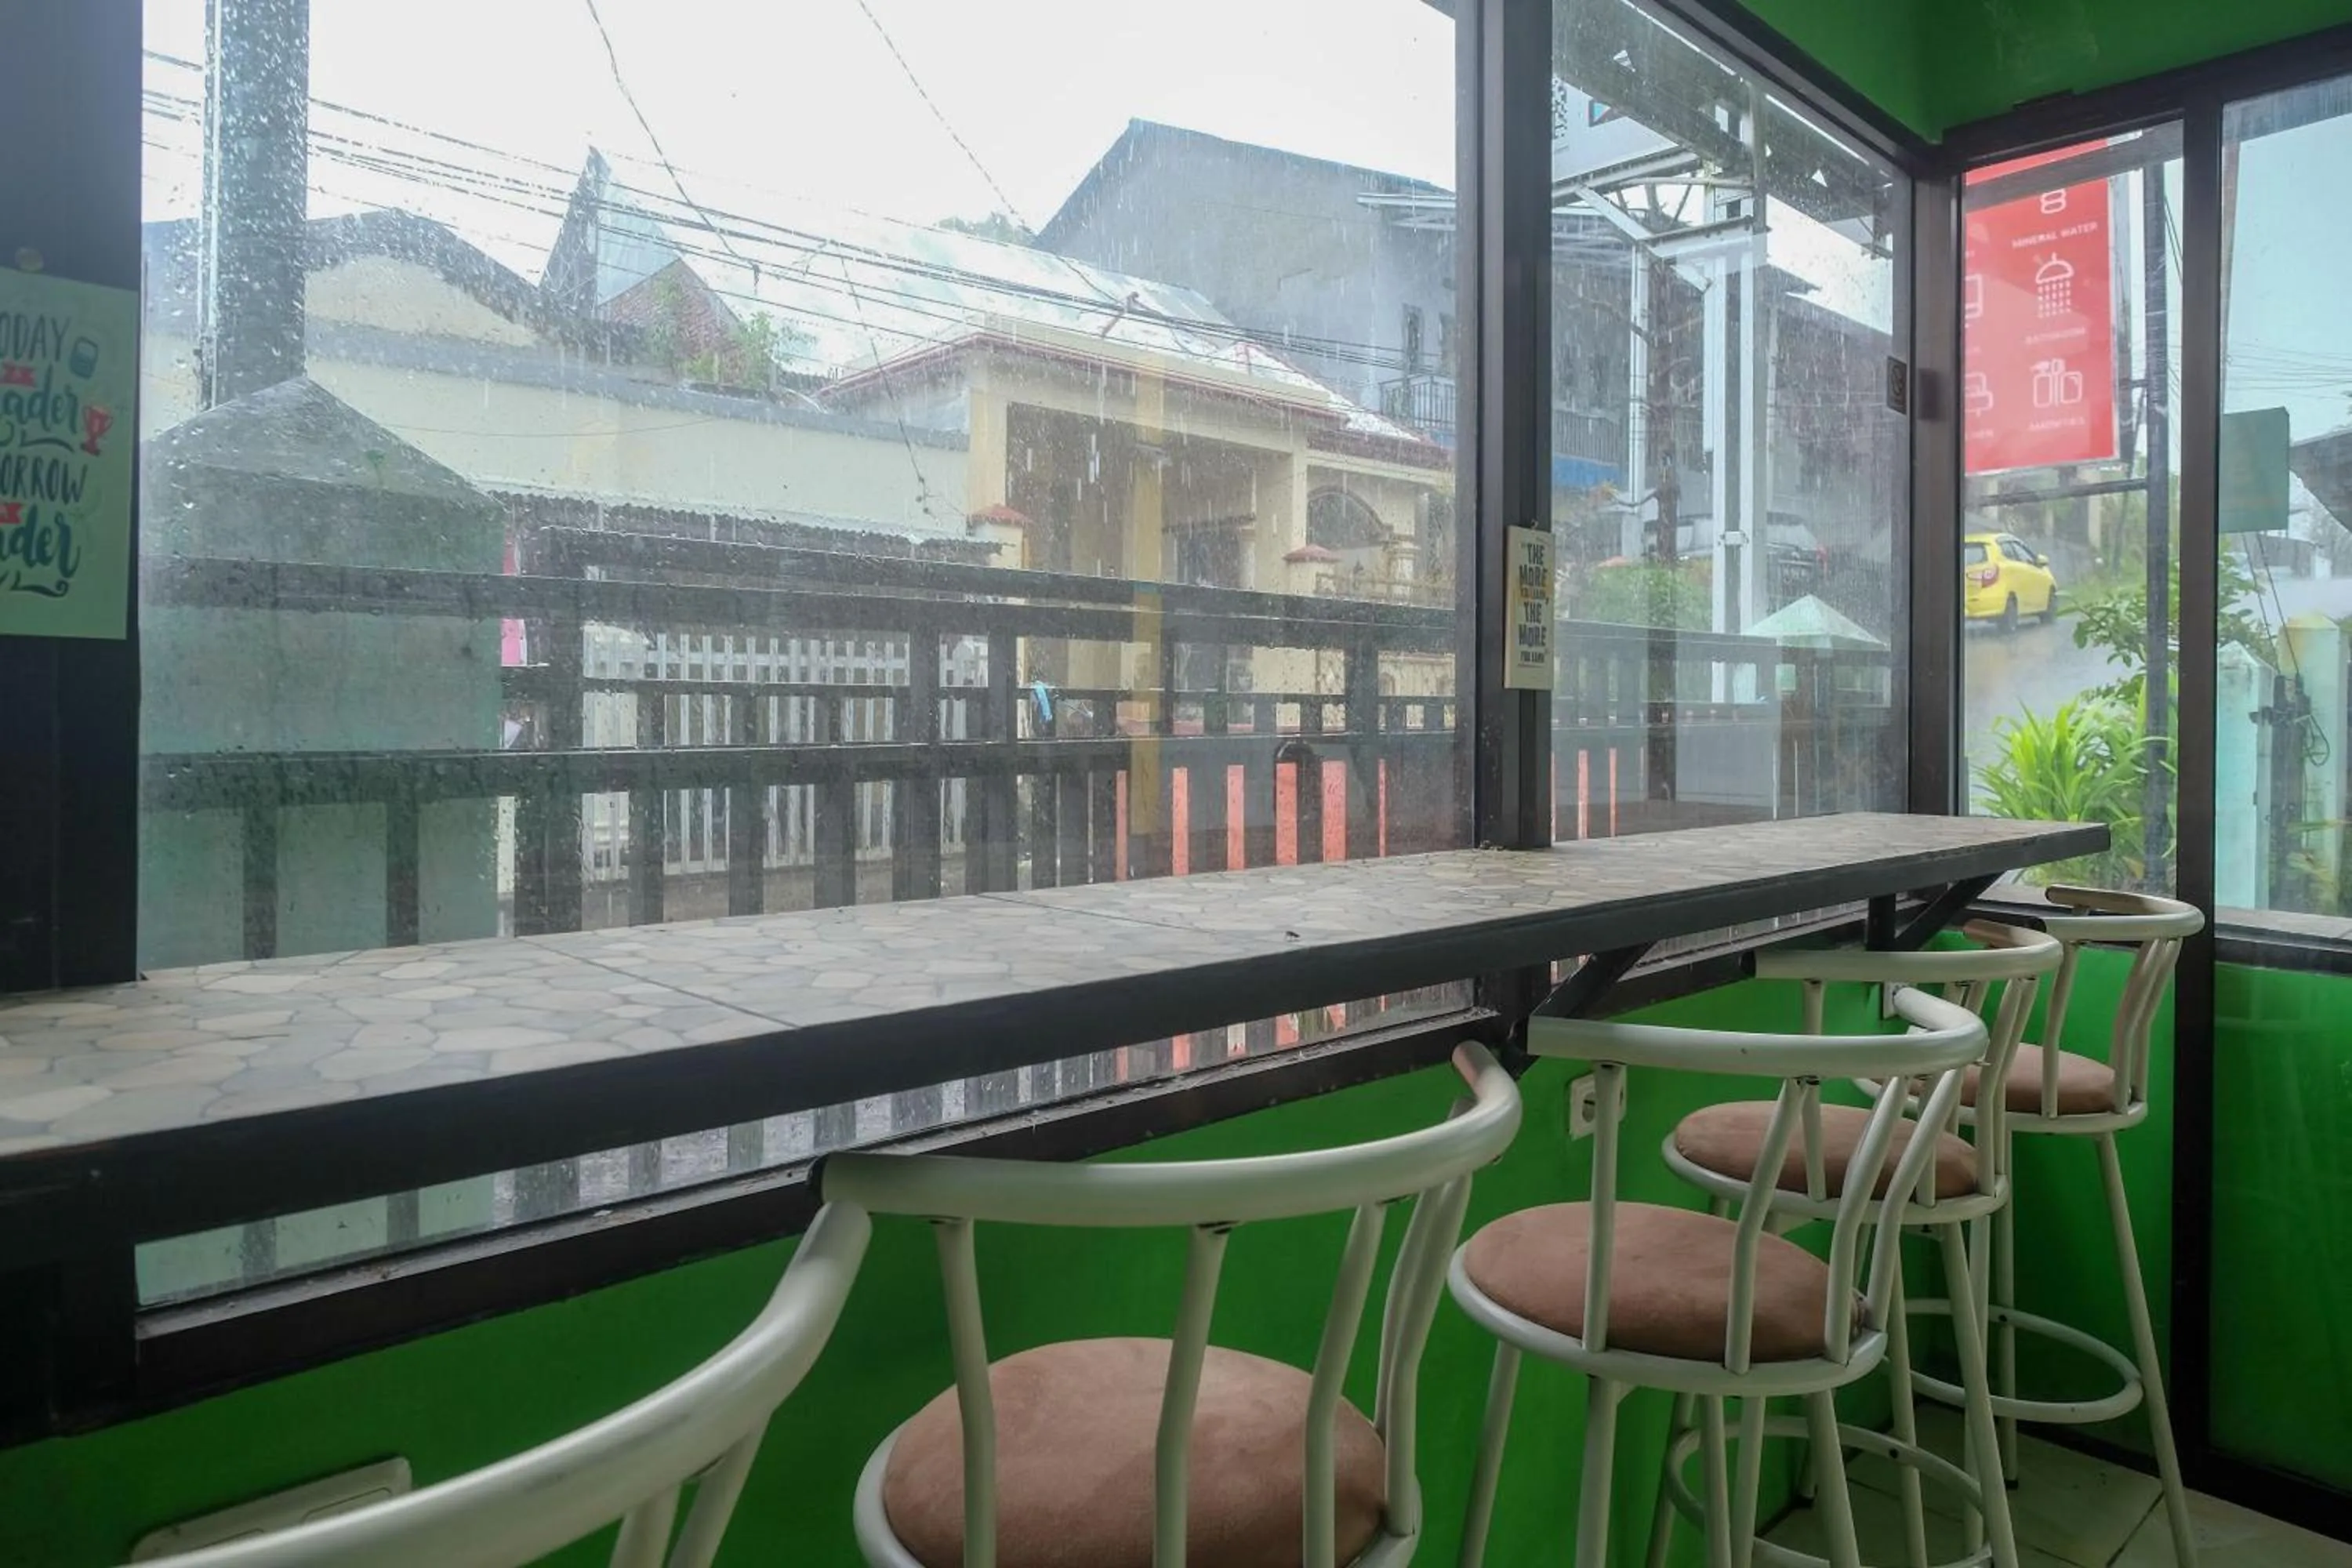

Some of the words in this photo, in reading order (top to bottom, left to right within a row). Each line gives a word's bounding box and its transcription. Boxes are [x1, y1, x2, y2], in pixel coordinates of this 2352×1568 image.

[2060, 221, 2099, 238] WATER
[1519, 564, 1548, 587] MORE
[1523, 601, 1542, 624] THE
[1519, 624, 1547, 647] MORE
